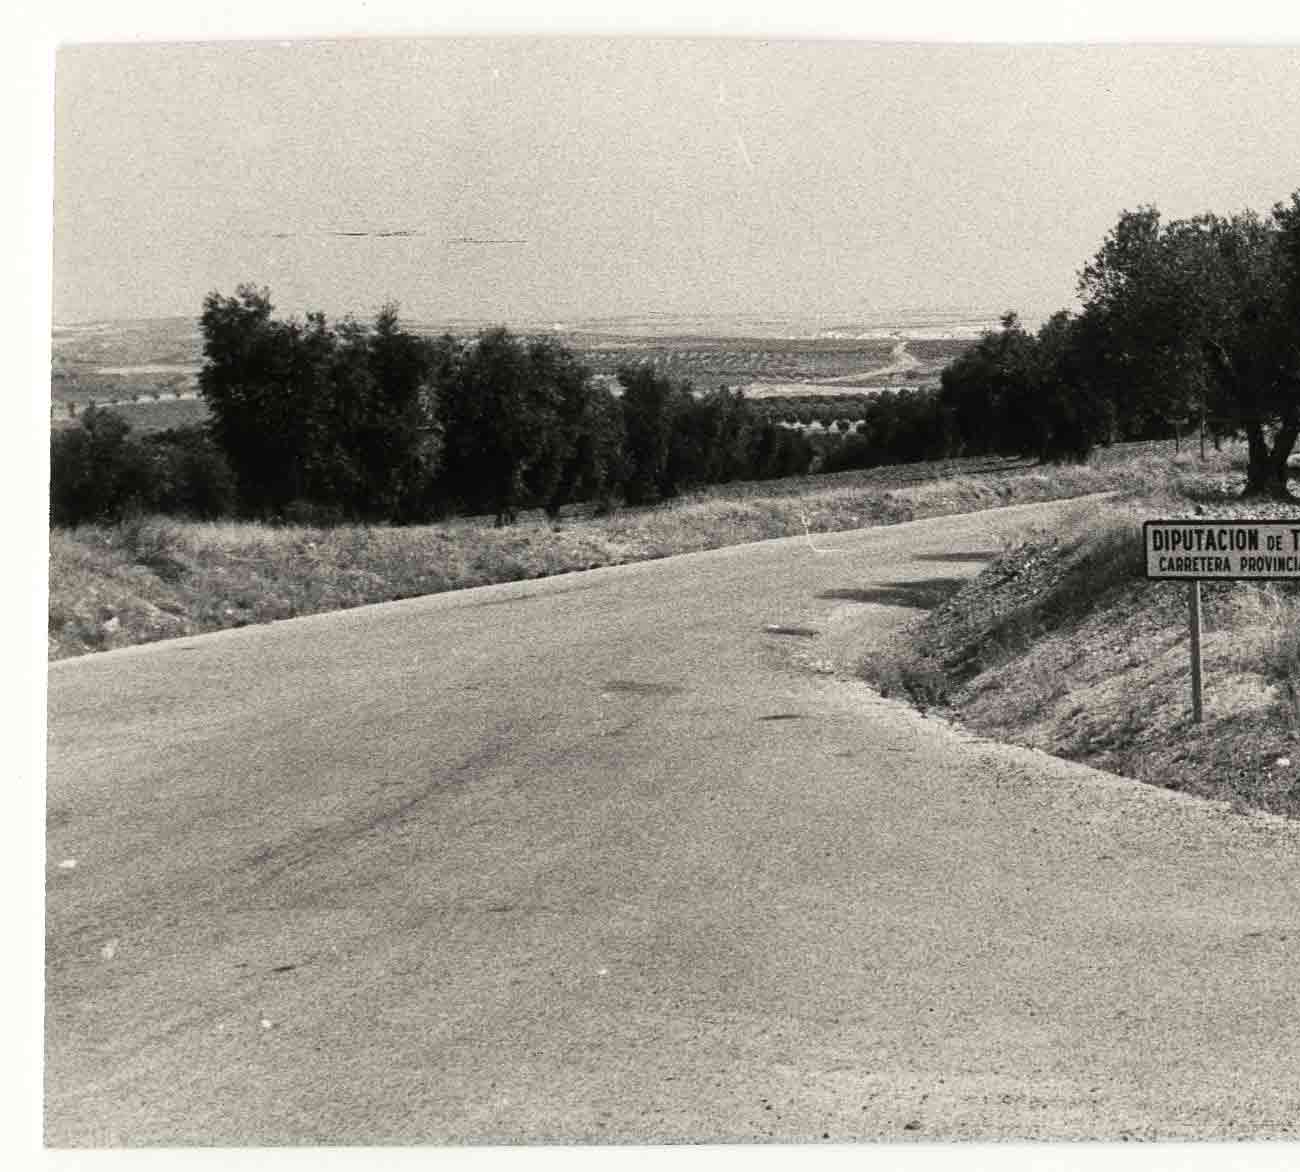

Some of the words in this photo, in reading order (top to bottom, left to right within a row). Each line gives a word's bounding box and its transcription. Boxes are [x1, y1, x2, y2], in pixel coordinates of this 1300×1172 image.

[1153, 528, 1259, 551] DIPUTACION
[1267, 535, 1283, 551] DE
[1159, 556, 1231, 572] CARRETERA
